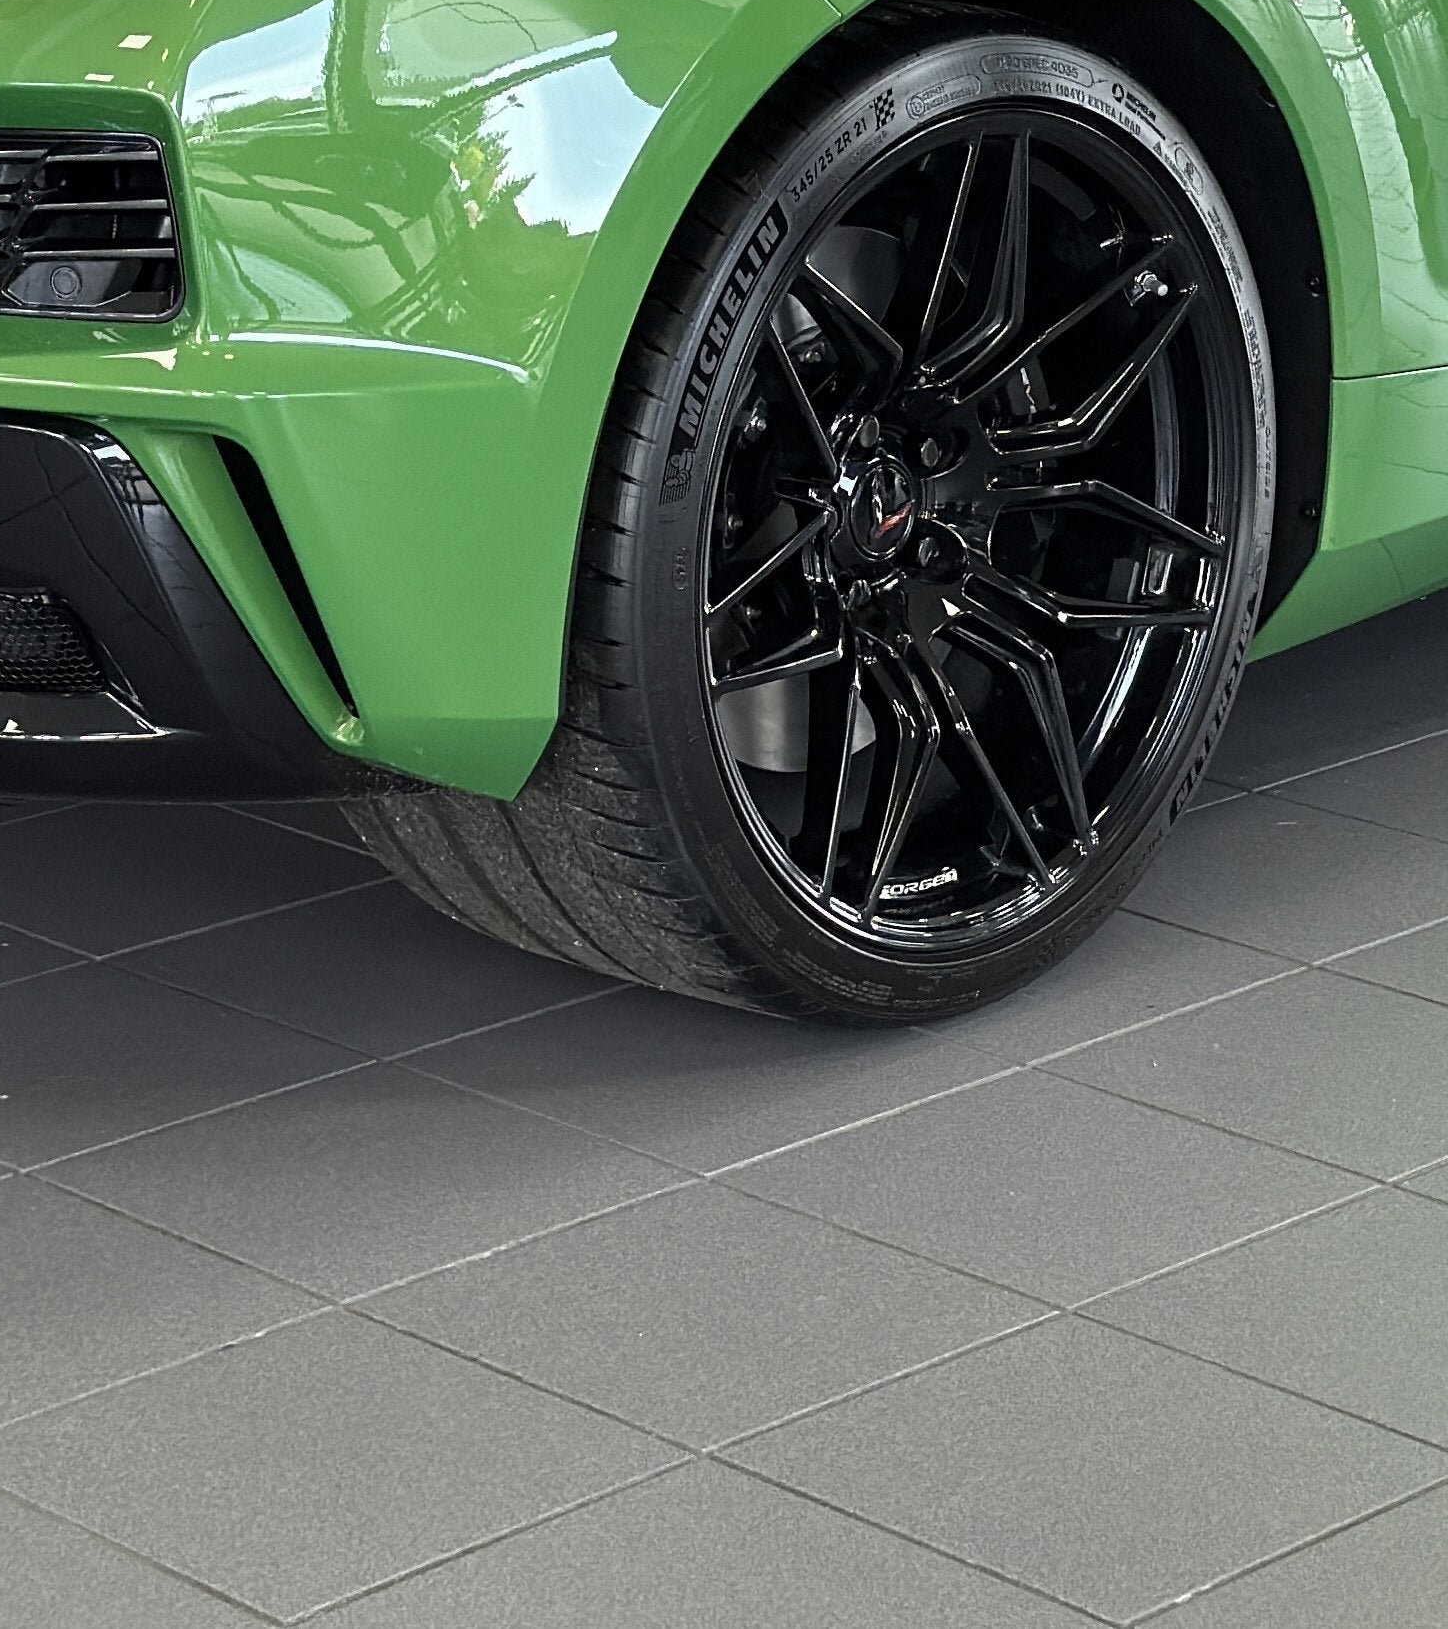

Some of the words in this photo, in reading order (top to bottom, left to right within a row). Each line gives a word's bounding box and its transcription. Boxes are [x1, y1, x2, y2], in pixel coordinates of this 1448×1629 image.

[834, 130, 852, 156] ZR
[853, 117, 869, 137] 21
[679, 216, 781, 439] MICHELIN
